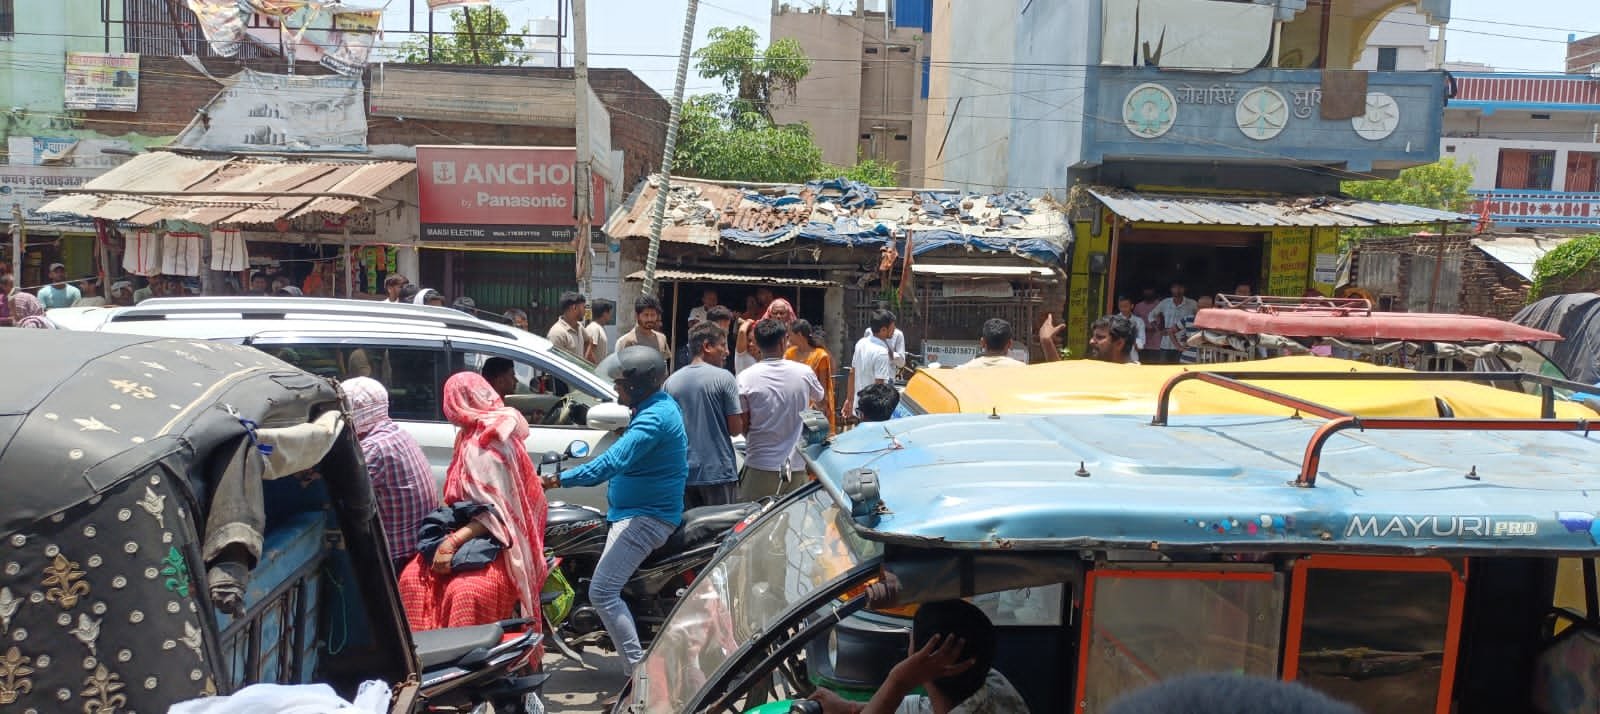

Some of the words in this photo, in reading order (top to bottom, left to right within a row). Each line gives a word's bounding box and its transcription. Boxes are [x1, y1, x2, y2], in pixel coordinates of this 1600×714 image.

[462, 199, 472, 208] by
[477, 192, 567, 208] Panasonic
[451, 229, 485, 237] ELECTRIC
[1347, 515, 1491, 537] MAYURI
[1494, 521, 1537, 536] PRO
